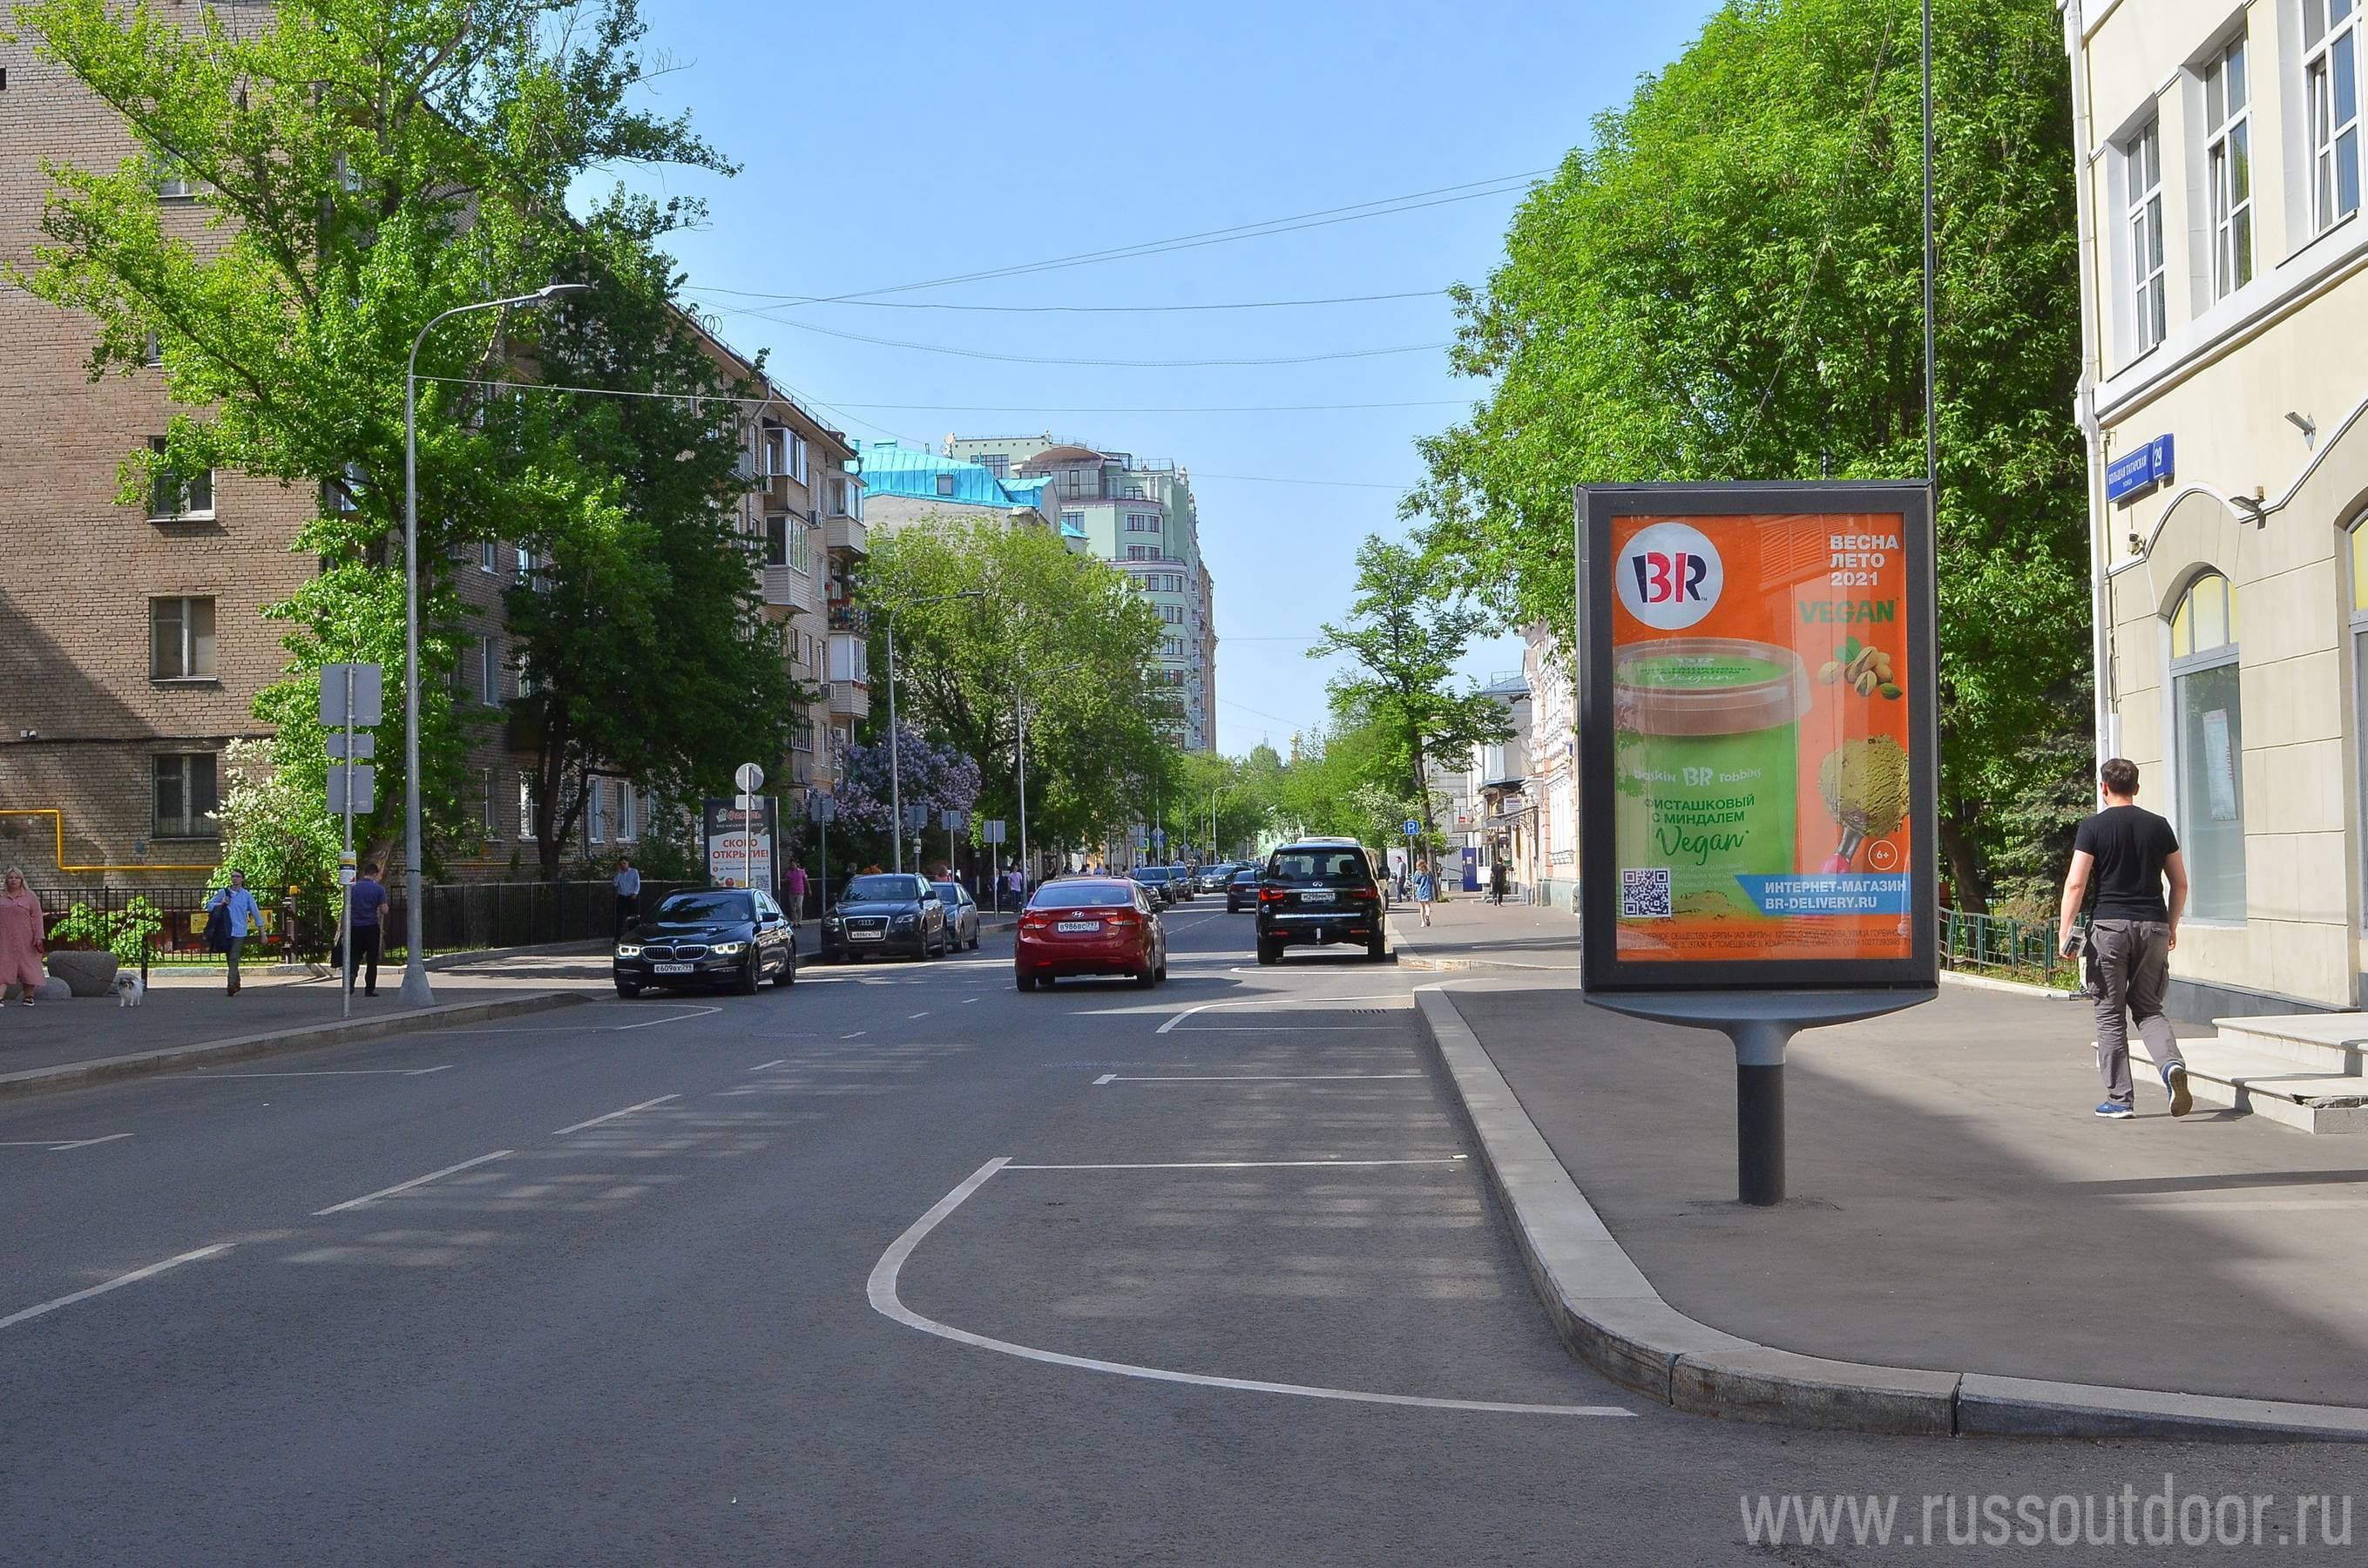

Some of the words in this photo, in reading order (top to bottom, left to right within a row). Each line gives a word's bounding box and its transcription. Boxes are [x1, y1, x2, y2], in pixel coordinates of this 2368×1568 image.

[1830, 534, 1899, 550] ВЕСНА
[1830, 553, 1885, 568] ЛЕТО
[1632, 551, 1708, 604] BR
[1831, 571, 1877, 586] 2021
[1645, 794, 1755, 811] ФИСТАШКОВЫЙ
[1653, 813, 1660, 822] С
[1665, 811, 1745, 826] МИНДАЛЕМ
[1407, 822, 1416, 833] P
[1876, 850, 1890, 859] 6+
[1765, 880, 1906, 893] ИНТЕРНЕТ-МАГАЗИН
[1765, 896, 1877, 909] BR-DELIVERY.RU
